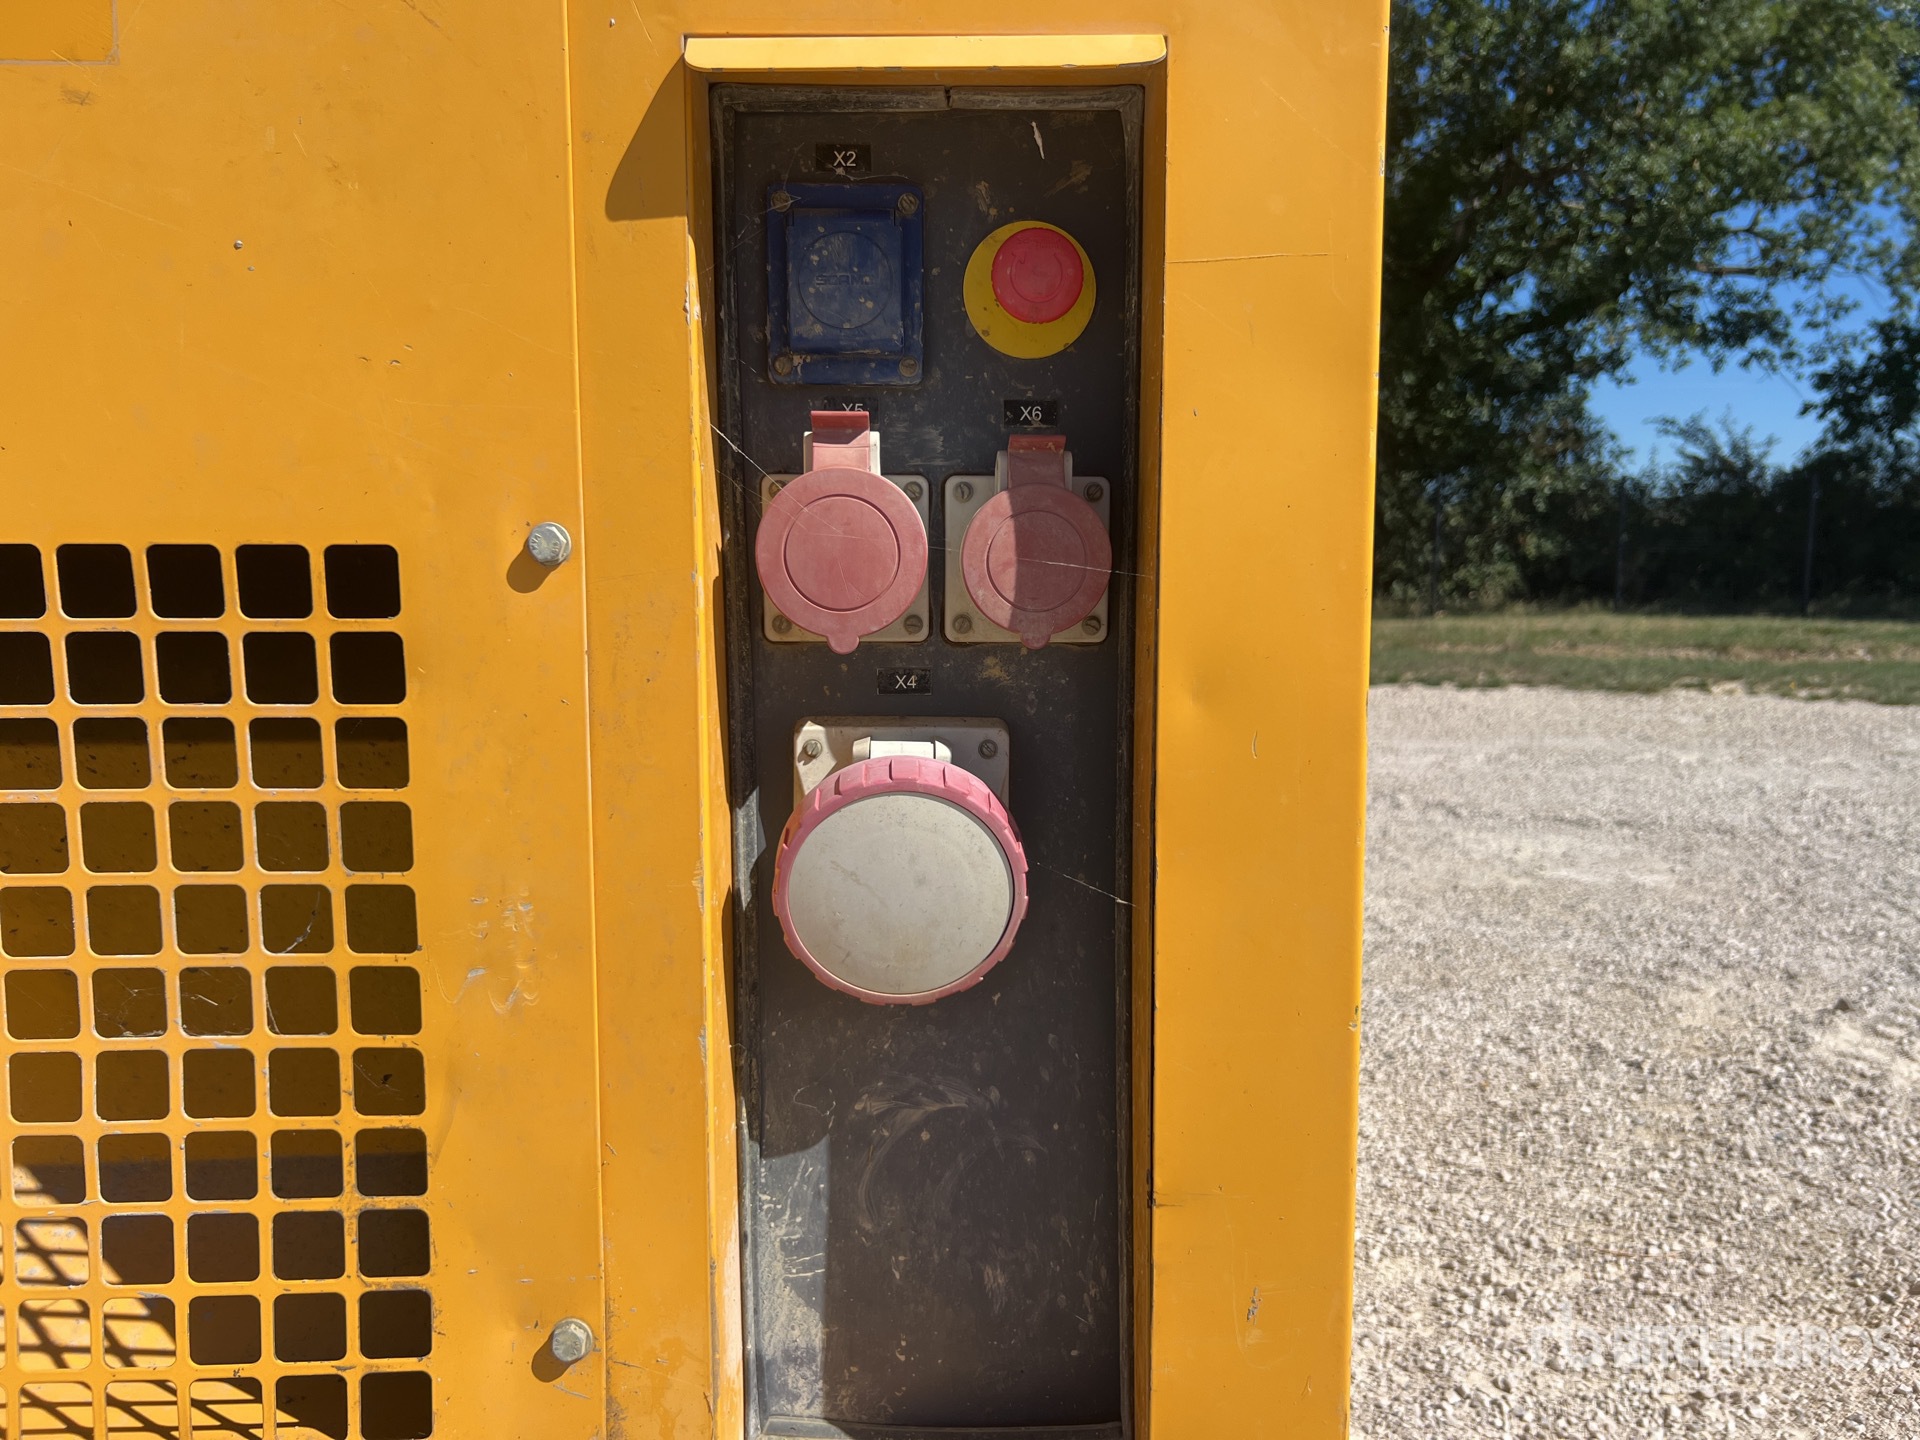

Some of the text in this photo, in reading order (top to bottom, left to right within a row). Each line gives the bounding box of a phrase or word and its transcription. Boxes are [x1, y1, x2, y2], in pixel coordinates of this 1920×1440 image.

[833, 150, 857, 167] X2
[1019, 405, 1042, 421] X6
[895, 674, 917, 689] X4
